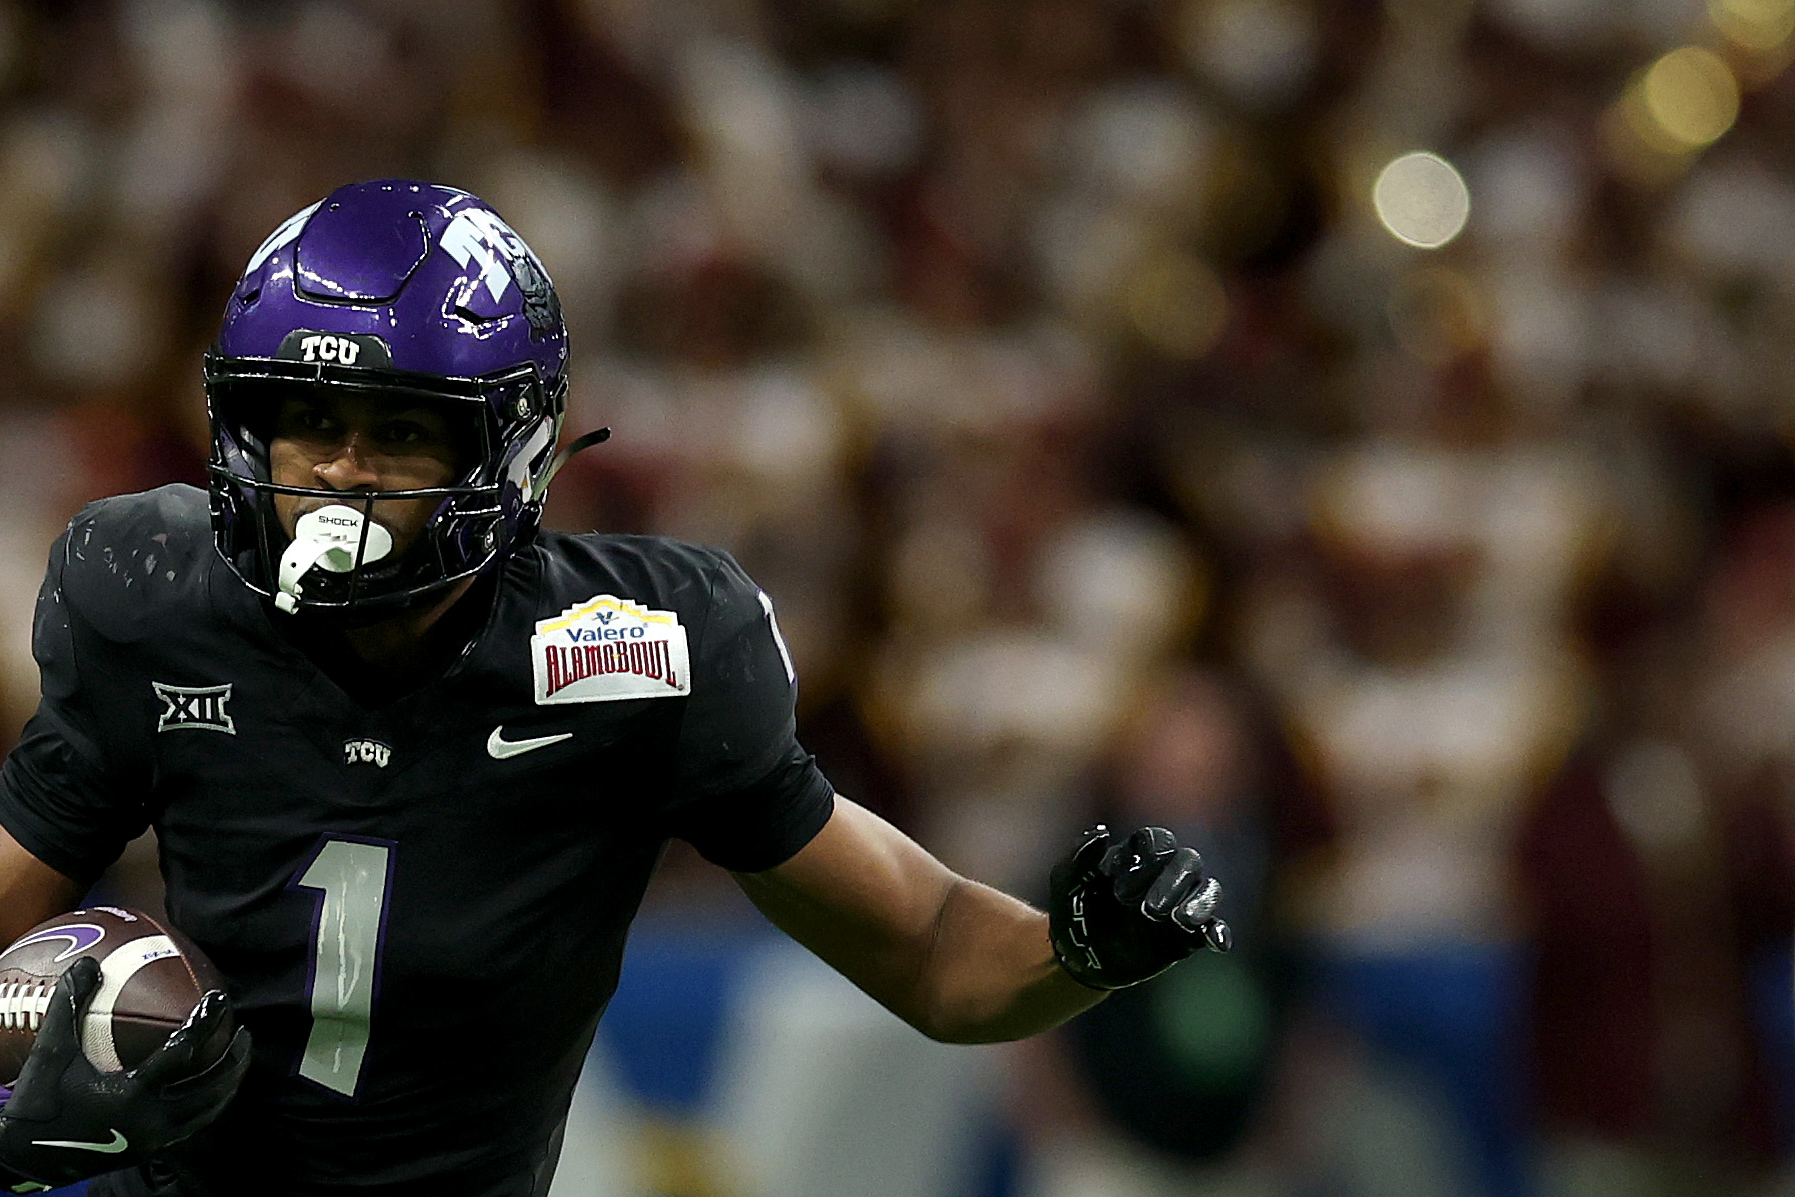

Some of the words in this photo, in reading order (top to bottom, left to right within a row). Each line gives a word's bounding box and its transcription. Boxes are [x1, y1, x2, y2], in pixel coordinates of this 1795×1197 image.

[300, 335, 360, 366] TCU
[318, 515, 359, 528] SHOCK
[344, 739, 392, 769] TCU
[289, 834, 396, 1100] 1
